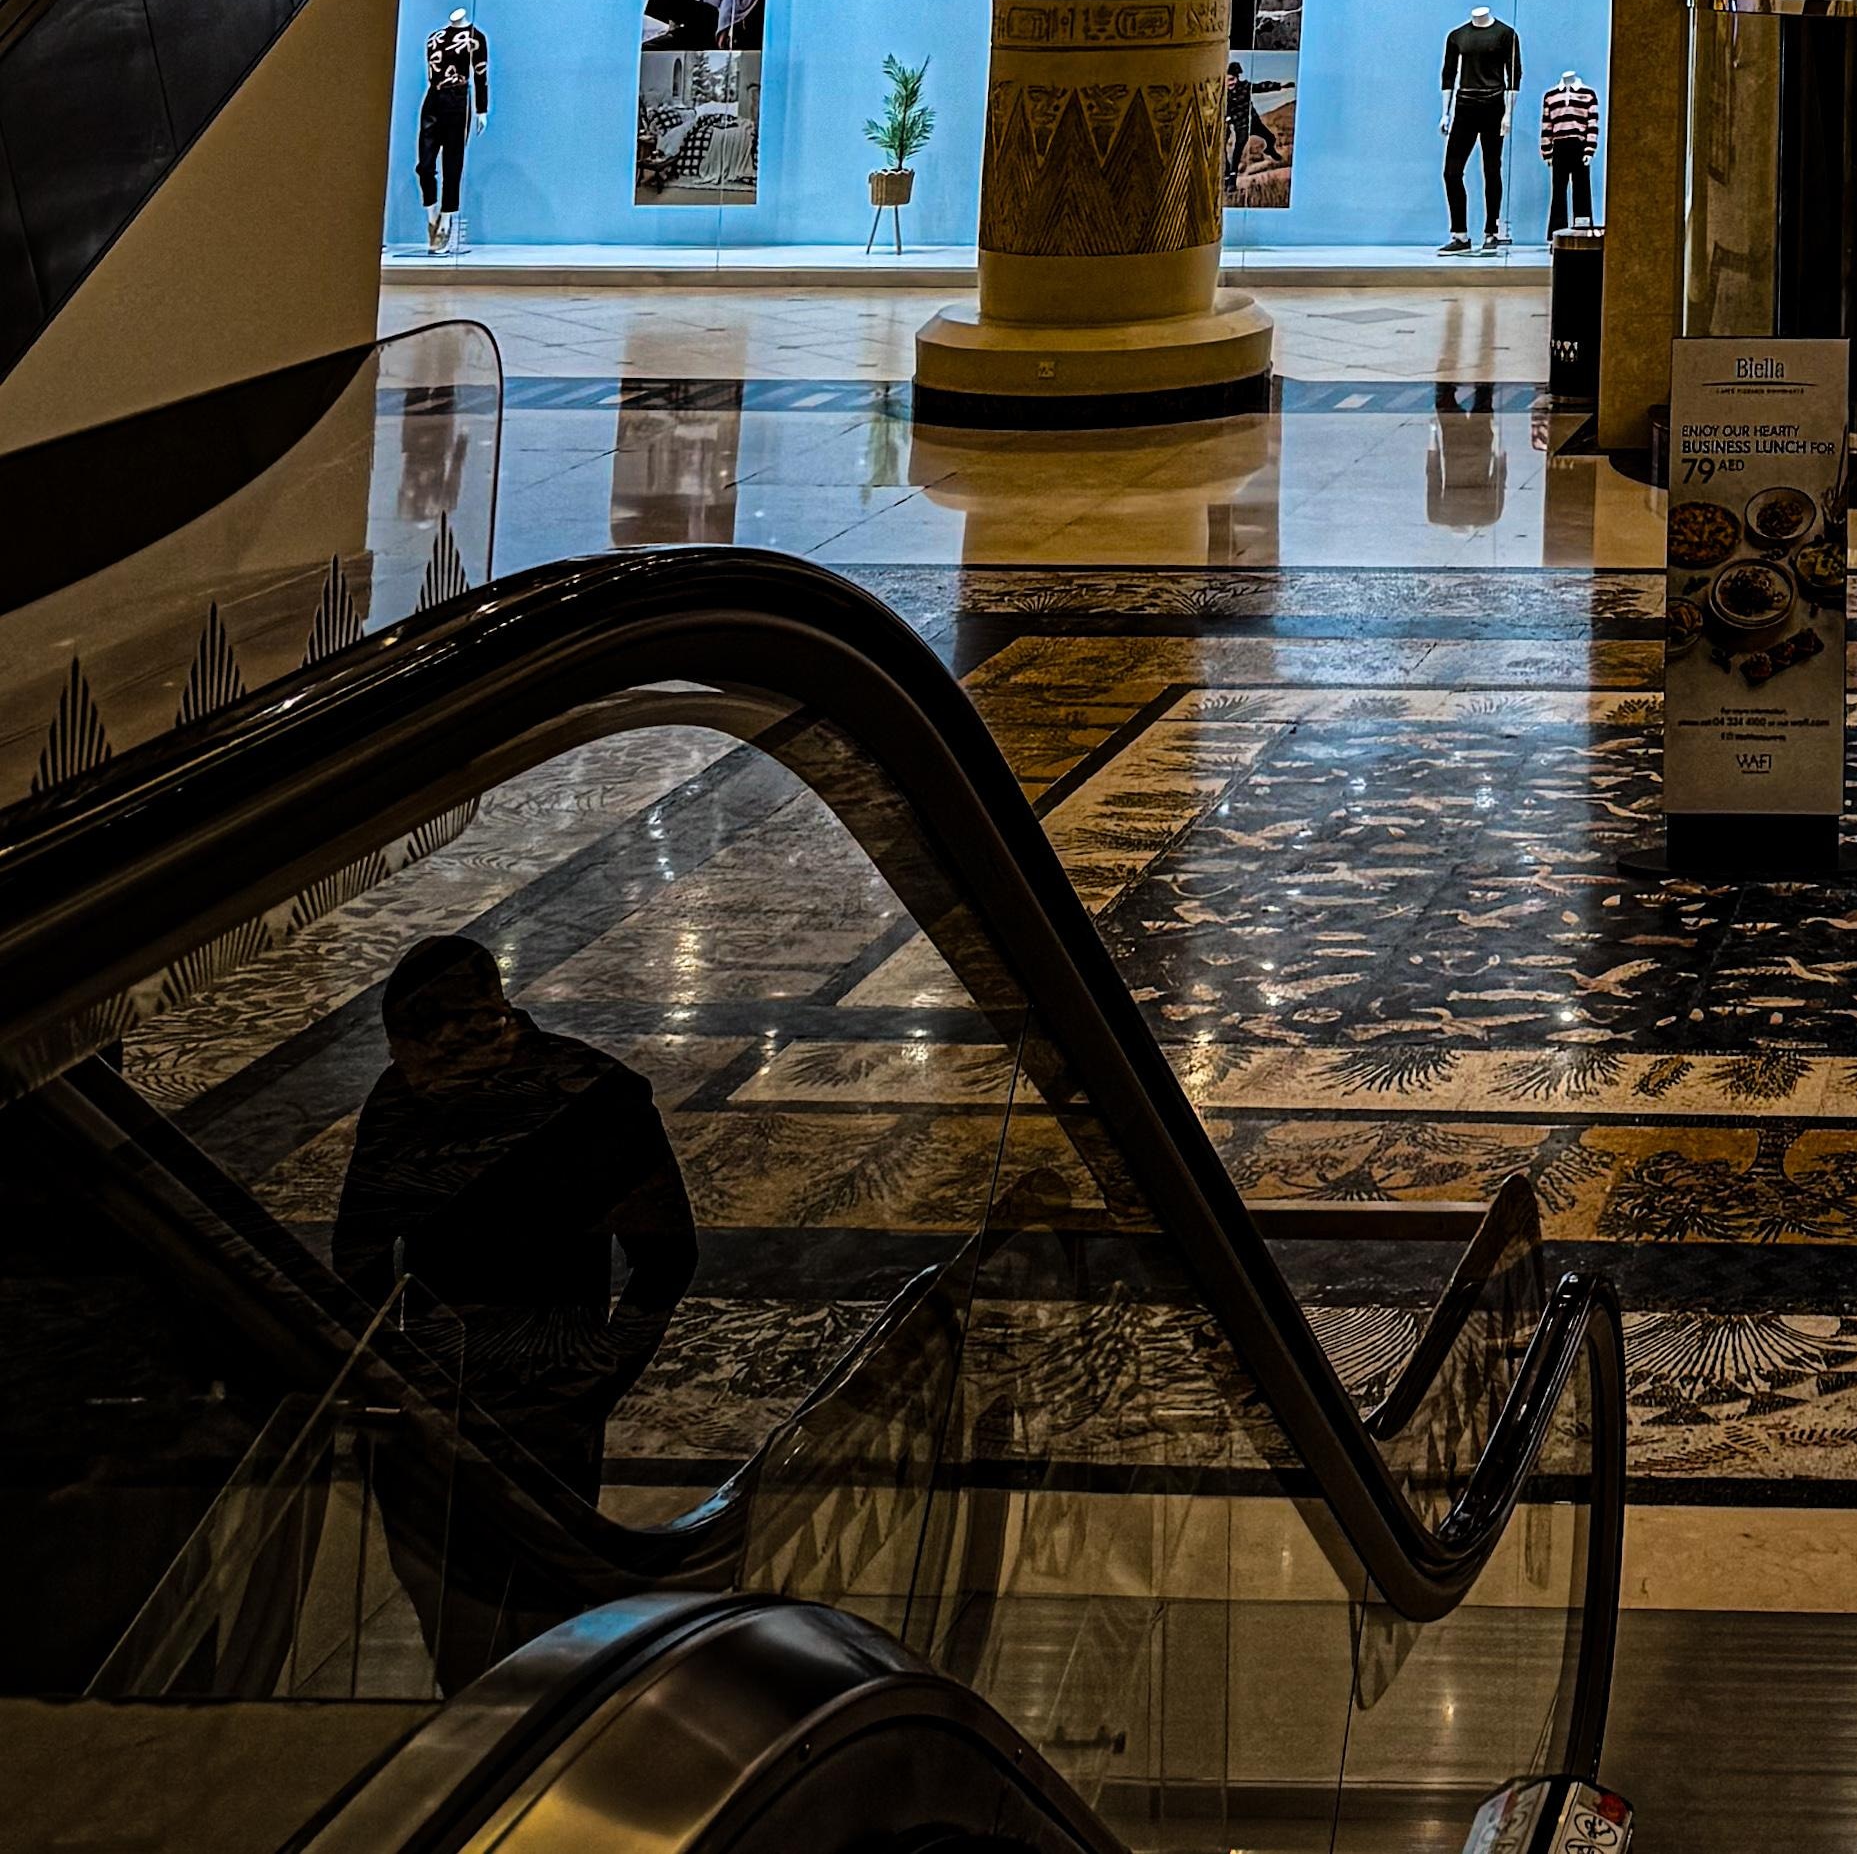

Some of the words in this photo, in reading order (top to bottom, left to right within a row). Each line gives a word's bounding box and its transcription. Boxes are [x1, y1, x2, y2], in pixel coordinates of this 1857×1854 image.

[1736, 357, 1785, 379] Biella
[1681, 425, 1719, 438] ENJOY
[1722, 425, 1750, 437] OUR
[1753, 425, 1800, 437] HEARTY
[1682, 440, 1751, 454] BUSINESS
[1755, 440, 1807, 454] LUNCH
[1810, 443, 1835, 454] FOR
[1681, 458, 1716, 484] 79
[1717, 459, 1745, 471] AED
